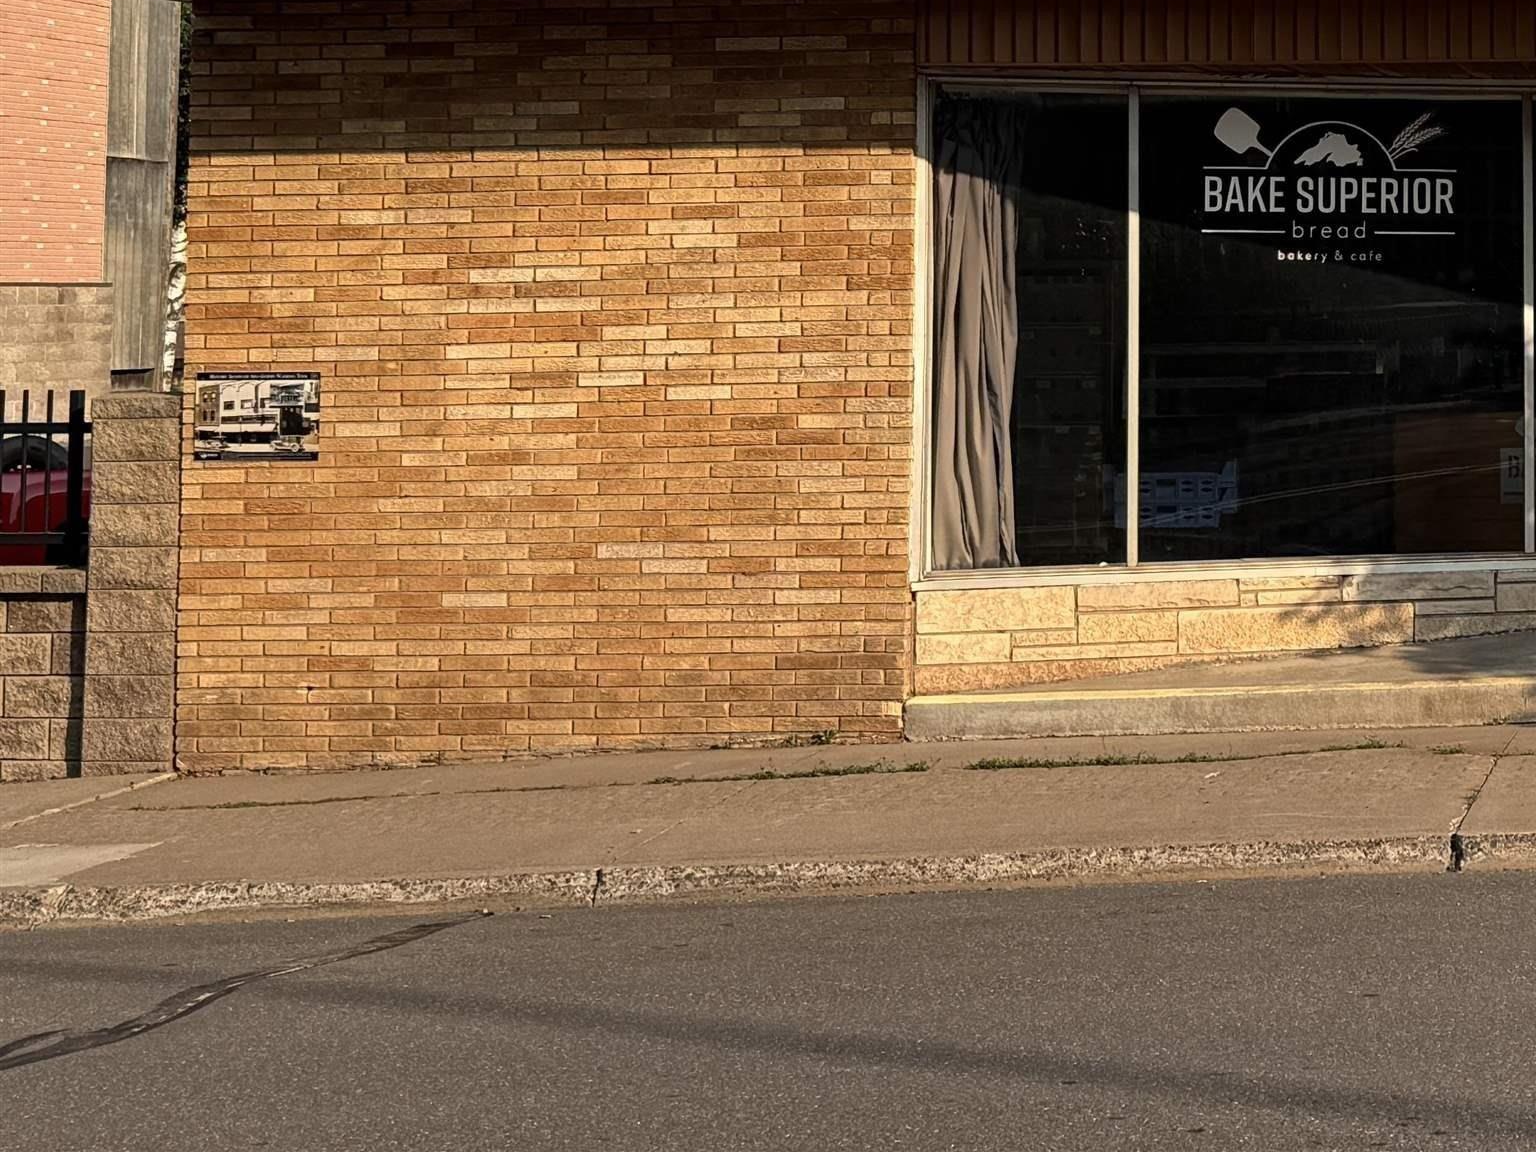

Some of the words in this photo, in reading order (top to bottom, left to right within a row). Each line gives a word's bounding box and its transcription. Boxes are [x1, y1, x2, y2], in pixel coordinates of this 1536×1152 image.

[1203, 175, 1286, 214] BAKE
[1295, 175, 1455, 215] SUPERIOR
[1291, 220, 1367, 240] bread
[1277, 249, 1329, 264] bakery
[1333, 249, 1344, 262] &
